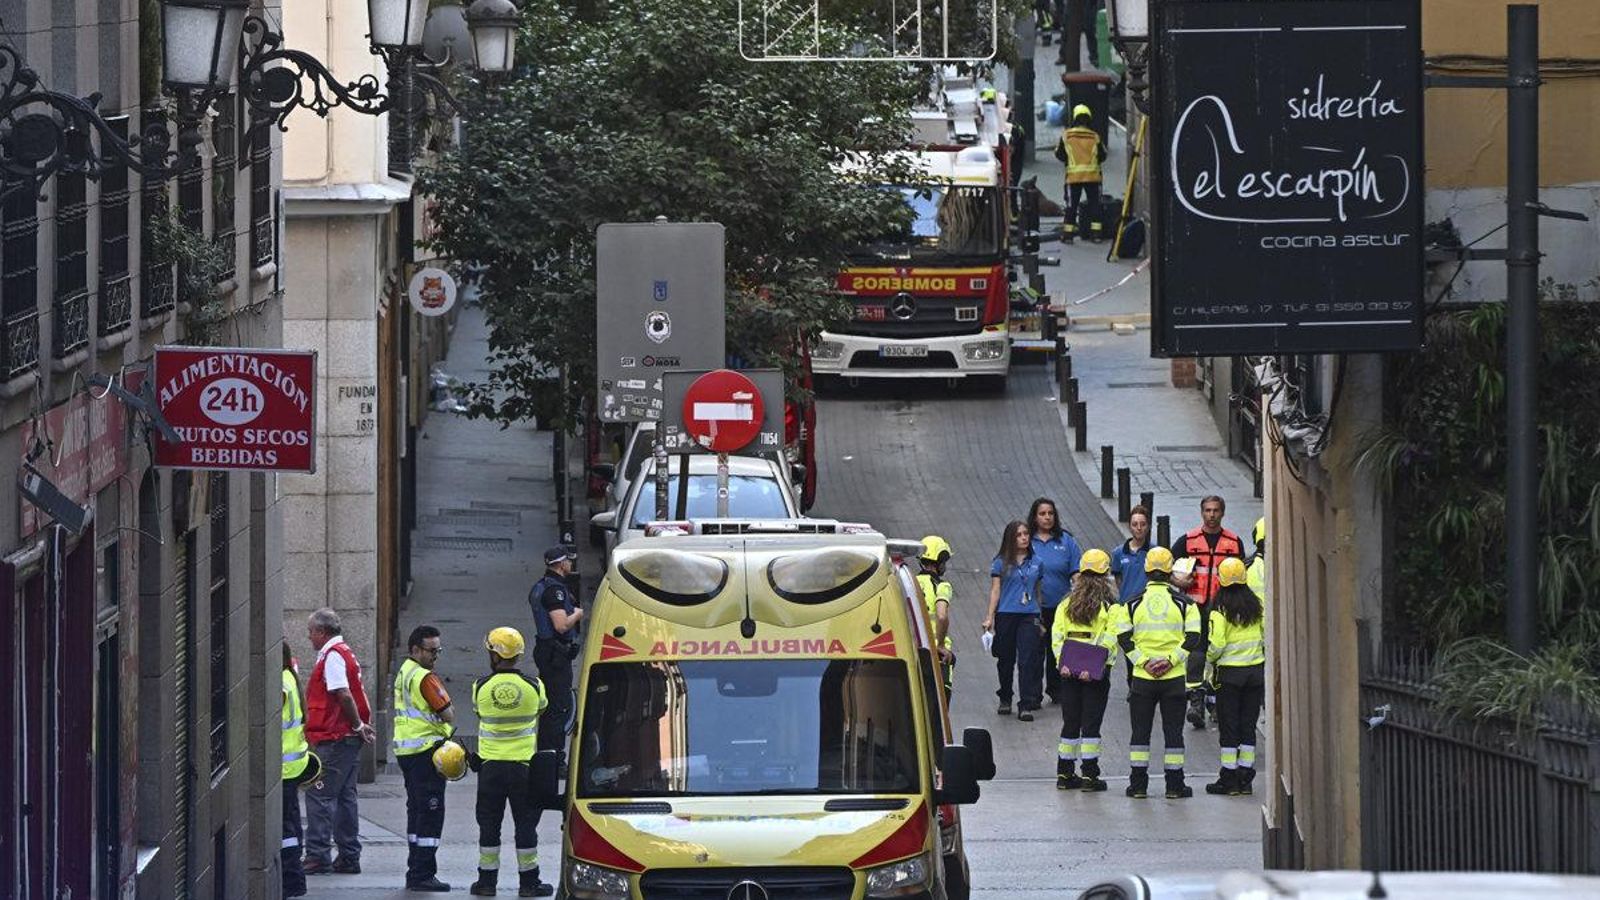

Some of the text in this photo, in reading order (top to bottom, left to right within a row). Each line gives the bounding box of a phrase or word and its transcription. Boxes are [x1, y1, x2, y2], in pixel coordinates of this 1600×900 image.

[1287, 73, 1406, 121] sidrería
[958, 187, 985, 197] 1717
[1237, 146, 1385, 222] escarpín
[1260, 233, 1410, 249] cocina astur
[159, 354, 310, 415] ALIMENTACIÓN
[206, 386, 259, 412] 24h
[161, 426, 310, 446] RUTOS SECOS
[191, 447, 278, 466] BEBIDAS
